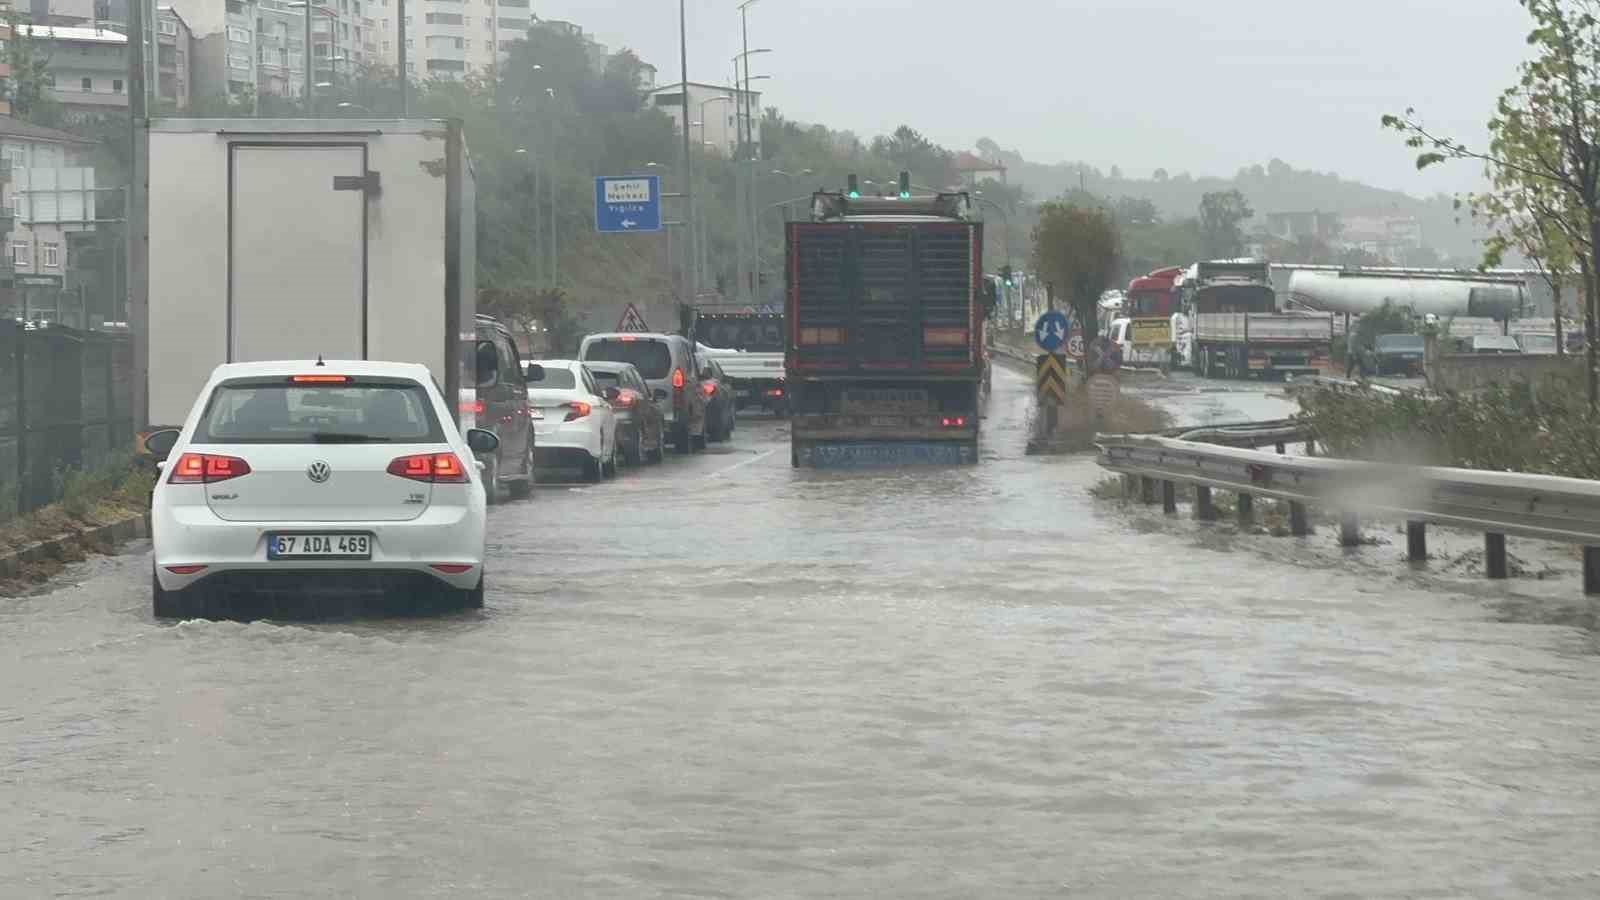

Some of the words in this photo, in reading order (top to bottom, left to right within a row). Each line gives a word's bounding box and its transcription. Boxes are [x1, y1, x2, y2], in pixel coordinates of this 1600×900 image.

[277, 536, 296, 553] 67
[303, 536, 332, 553] ADA
[338, 536, 368, 553] 469
